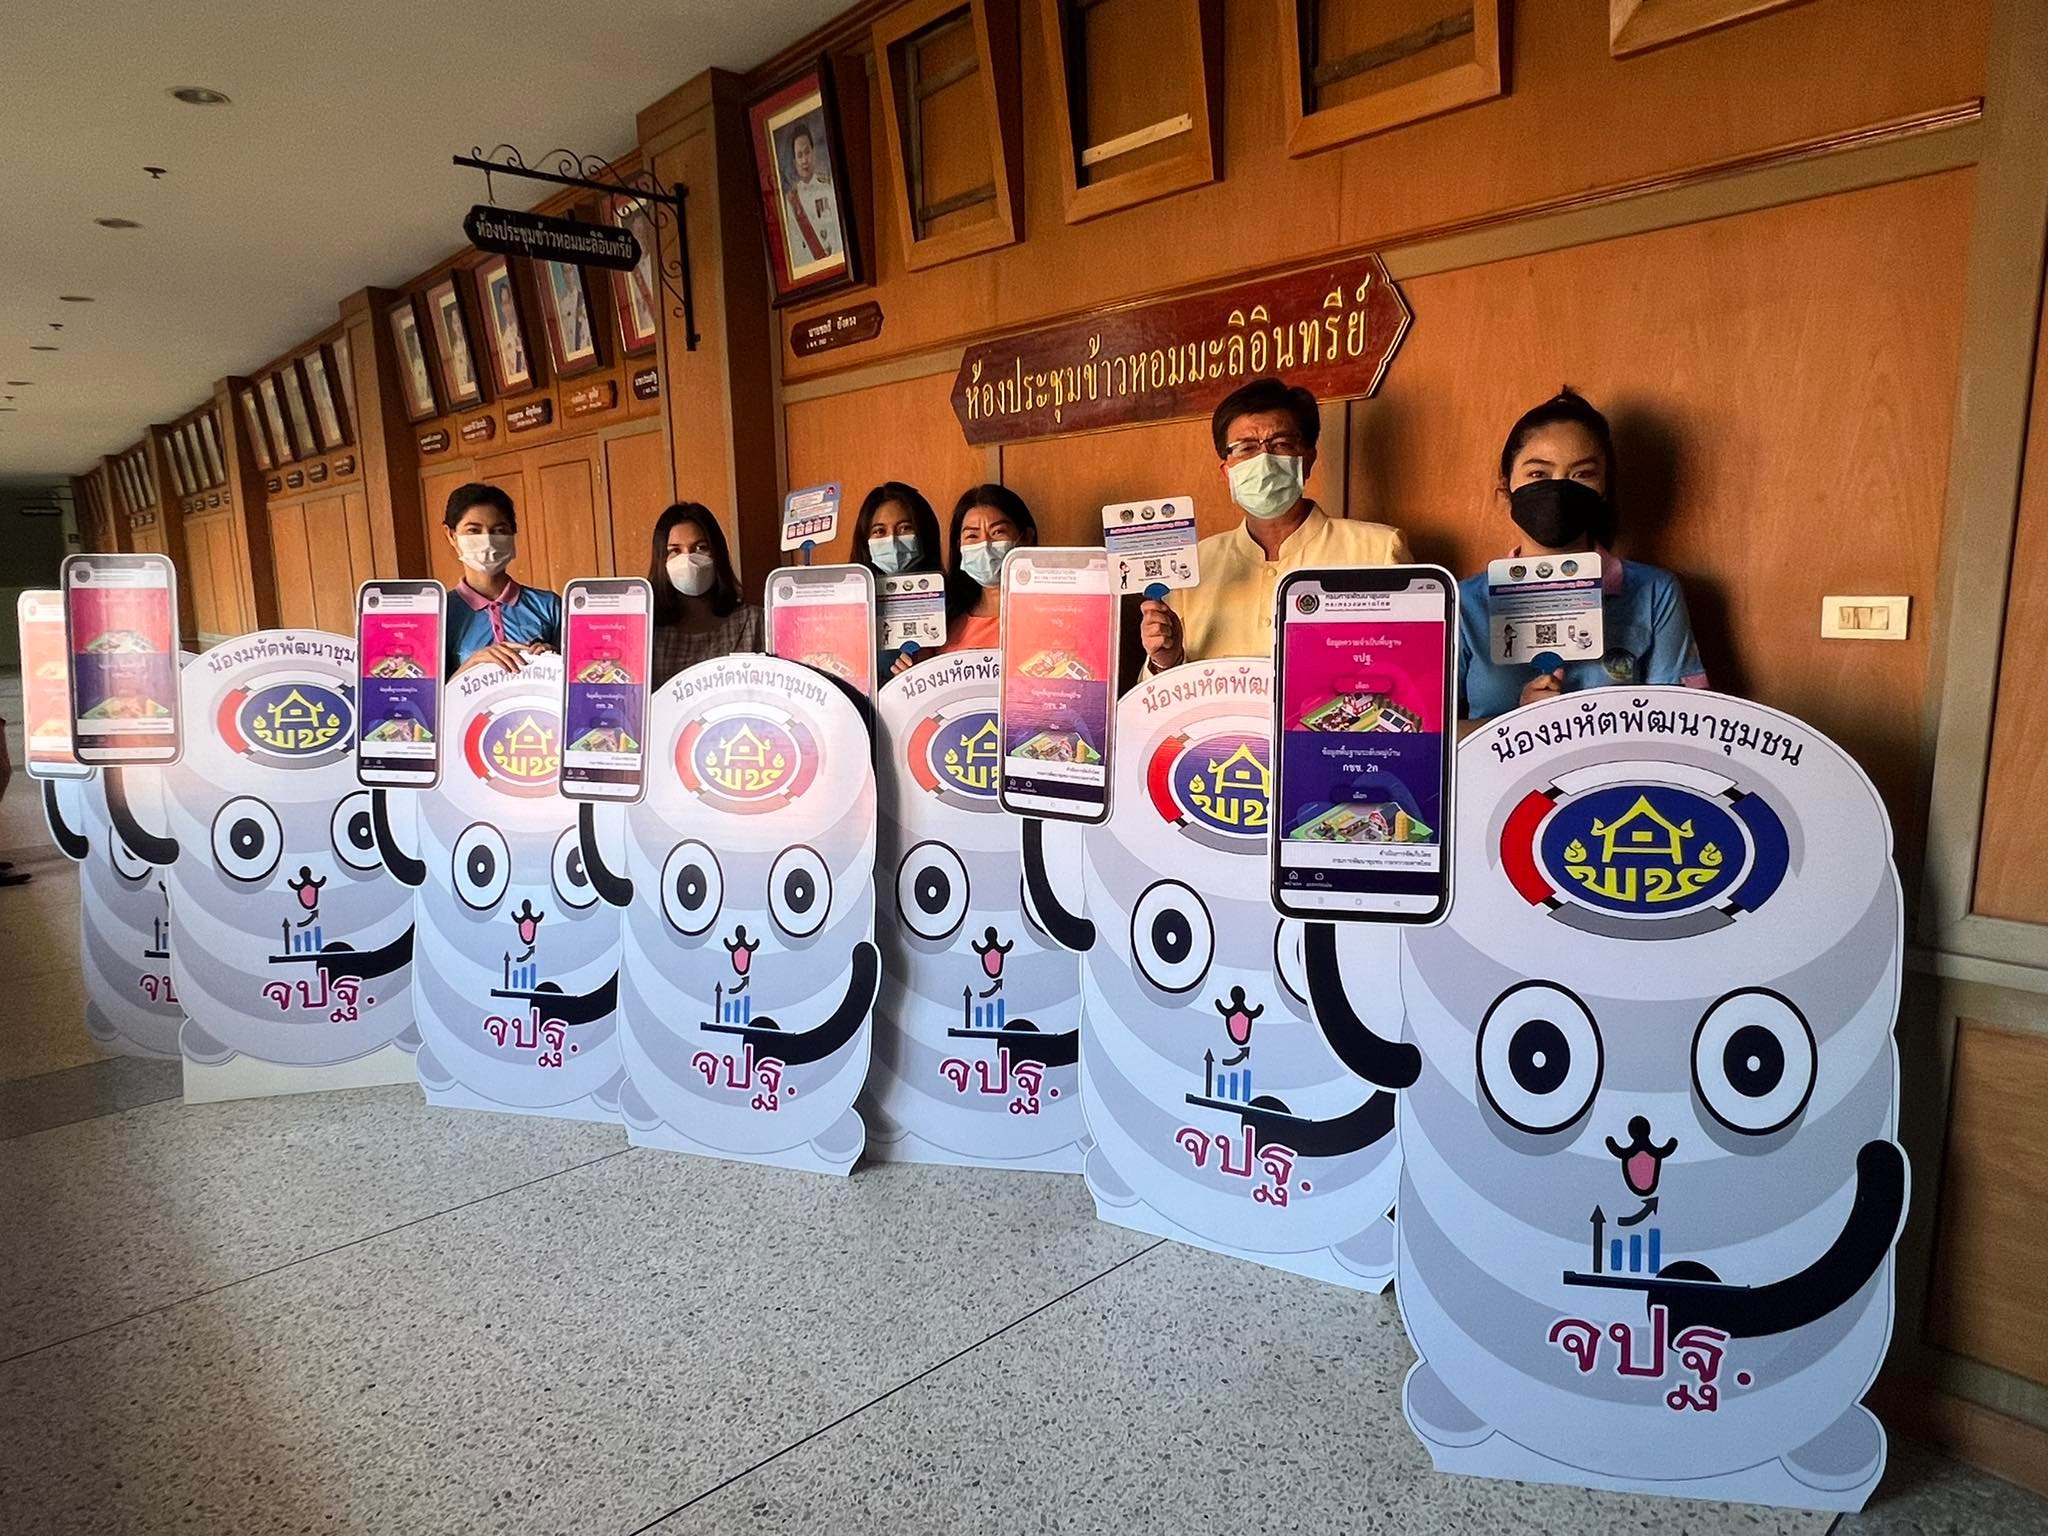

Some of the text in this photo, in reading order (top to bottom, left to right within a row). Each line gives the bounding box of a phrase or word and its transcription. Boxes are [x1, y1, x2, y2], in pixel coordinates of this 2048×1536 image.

[475, 212, 633, 259] ห้องประชุมข้าวหอมมะลิอินทรีย์
[965, 273, 1372, 423] ห้องประชุมข้าวหอมมะลิอินทรีย์
[672, 662, 828, 706] น้องมหัตพัฒนาชุมชน
[1491, 698, 1804, 766] น้องมหัตพัฒนาชุมชน
[263, 968, 375, 1023] จปฐ.
[483, 1006, 578, 1068] จปฐ.
[692, 1043, 796, 1111] จปฐ.
[939, 1047, 1059, 1115] จปฐ.
[1175, 1124, 1313, 1208] จปฐ.
[1549, 1307, 1752, 1412] จปฐ.
